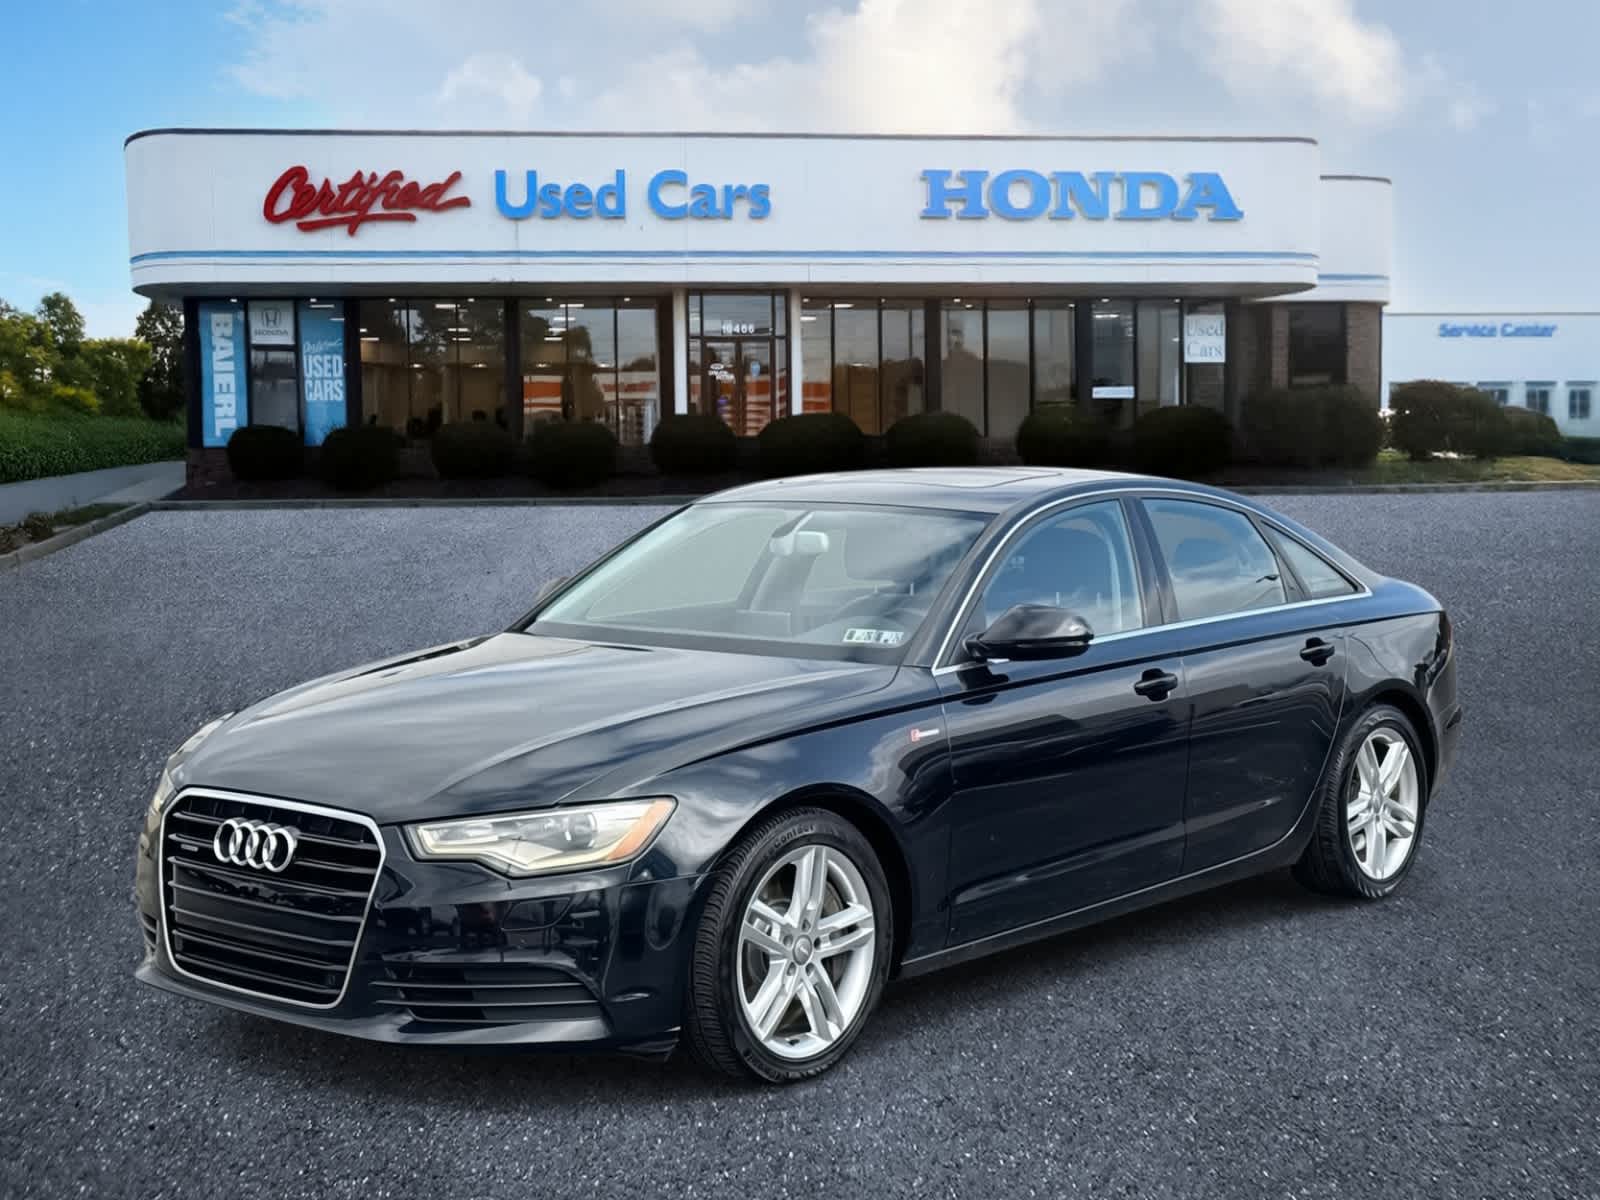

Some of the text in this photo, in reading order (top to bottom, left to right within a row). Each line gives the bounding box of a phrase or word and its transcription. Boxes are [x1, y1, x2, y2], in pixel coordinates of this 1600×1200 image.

[264, 165, 771, 236] Certified Used Cars
[920, 169, 1244, 221] HONDA
[1186, 319, 1224, 337] Used
[1439, 323, 1557, 337] Service Center
[1187, 341, 1223, 358] Cars
[210, 312, 237, 437] BAIERL
[303, 354, 343, 378] USED
[304, 379, 344, 401] CARS
